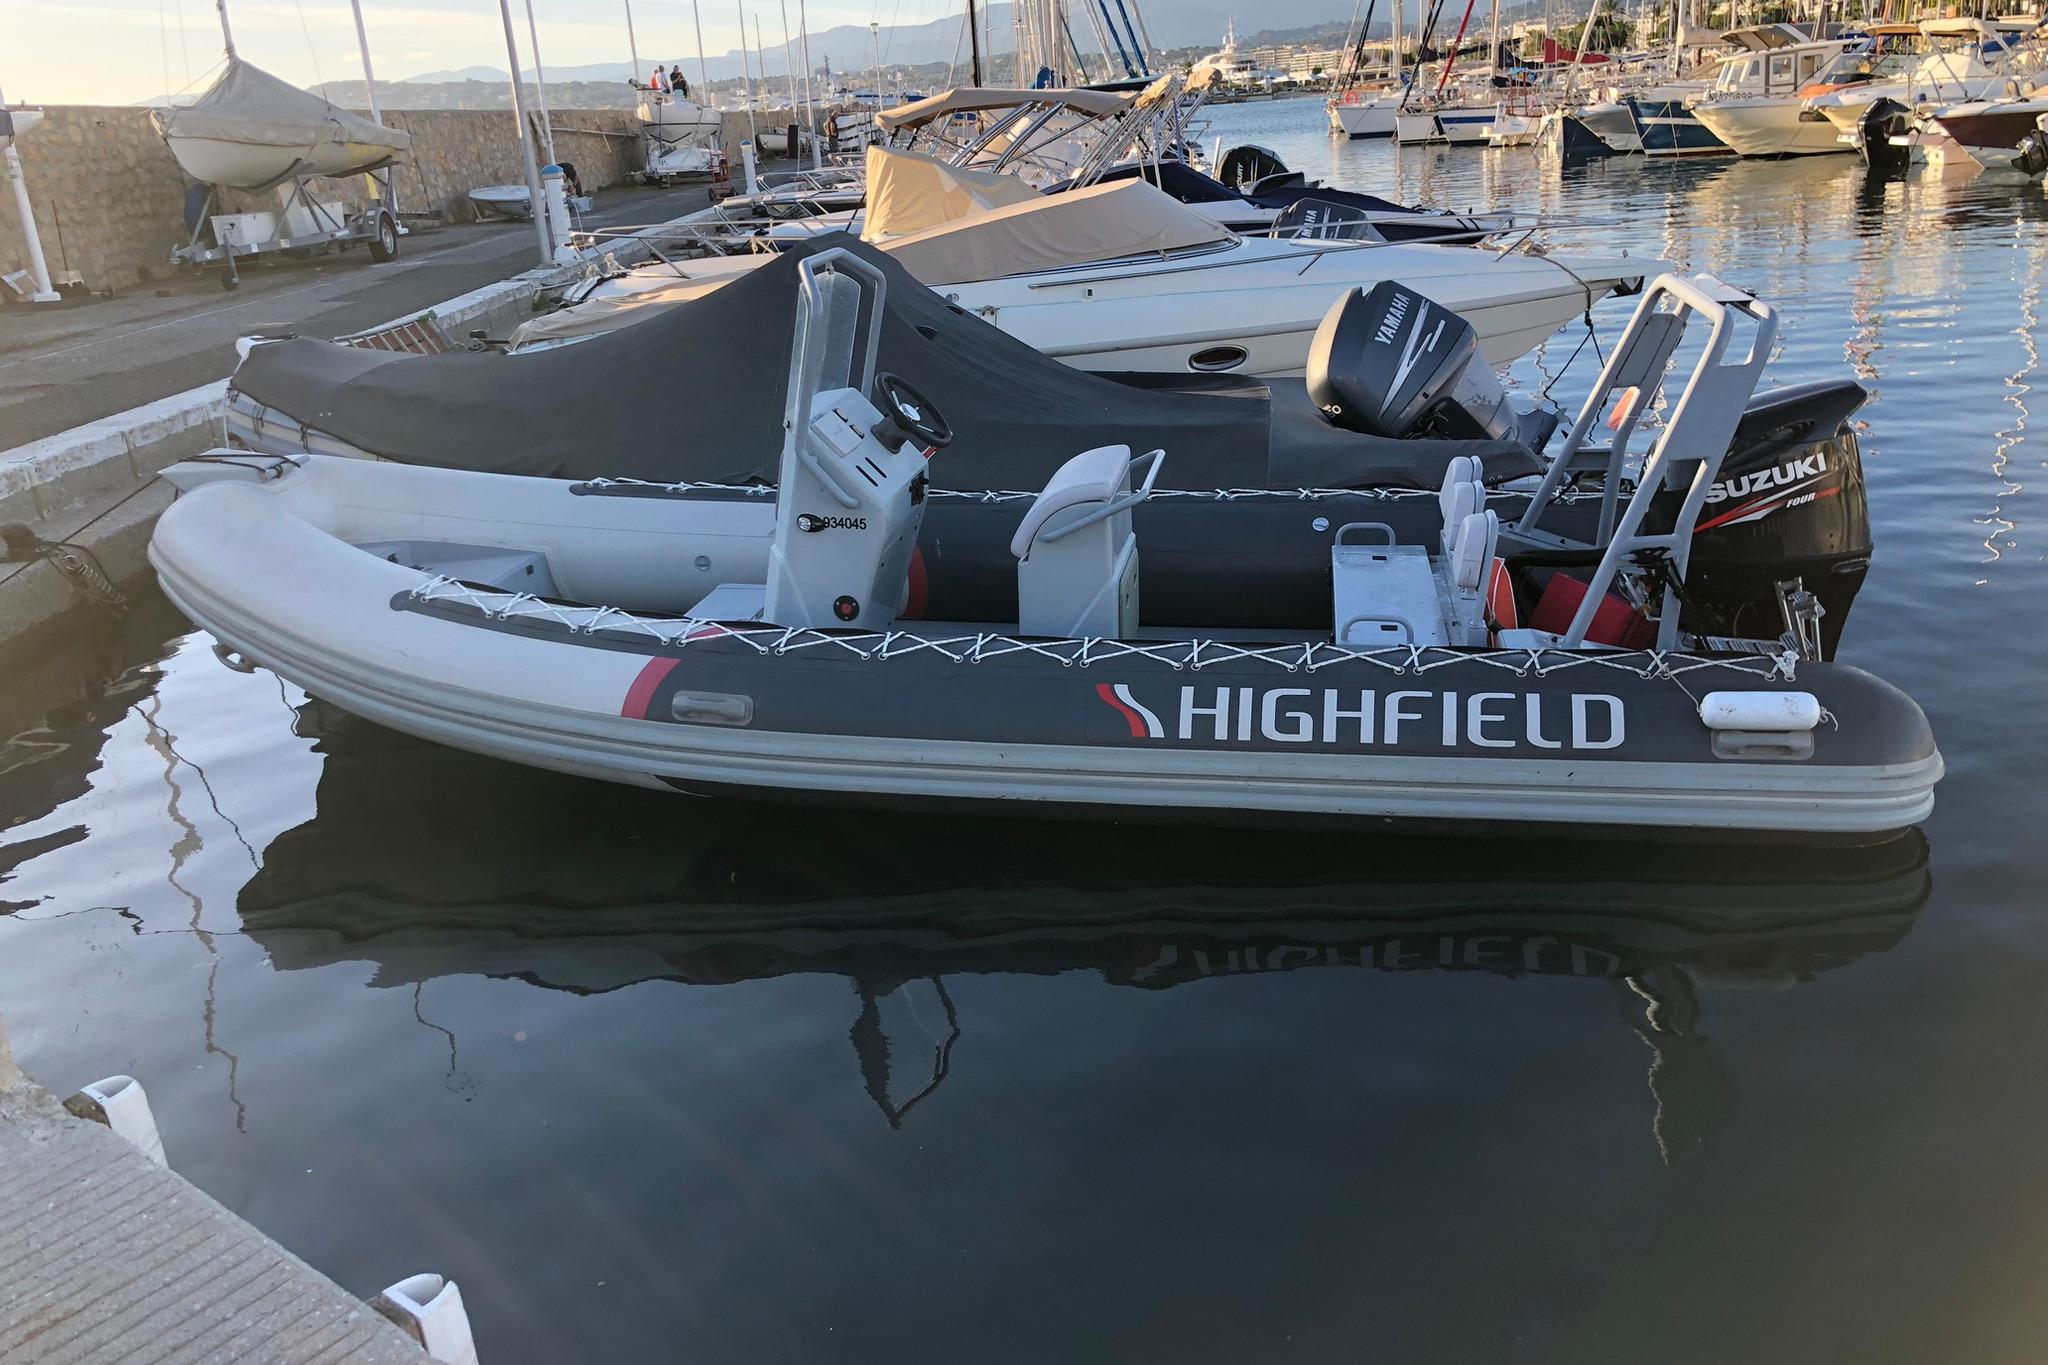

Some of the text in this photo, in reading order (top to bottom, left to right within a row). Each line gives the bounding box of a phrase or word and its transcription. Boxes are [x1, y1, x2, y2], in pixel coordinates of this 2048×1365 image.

[1236, 162, 1244, 187] CURY
[1301, 210, 1318, 239] MAHA
[1374, 292, 1411, 345] YAMAHA
[1705, 452, 1827, 504] SUZUKI
[1786, 491, 1816, 508] FOUR
[823, 516, 867, 530] 934045
[1178, 685, 1625, 750] HIGHFIELD
